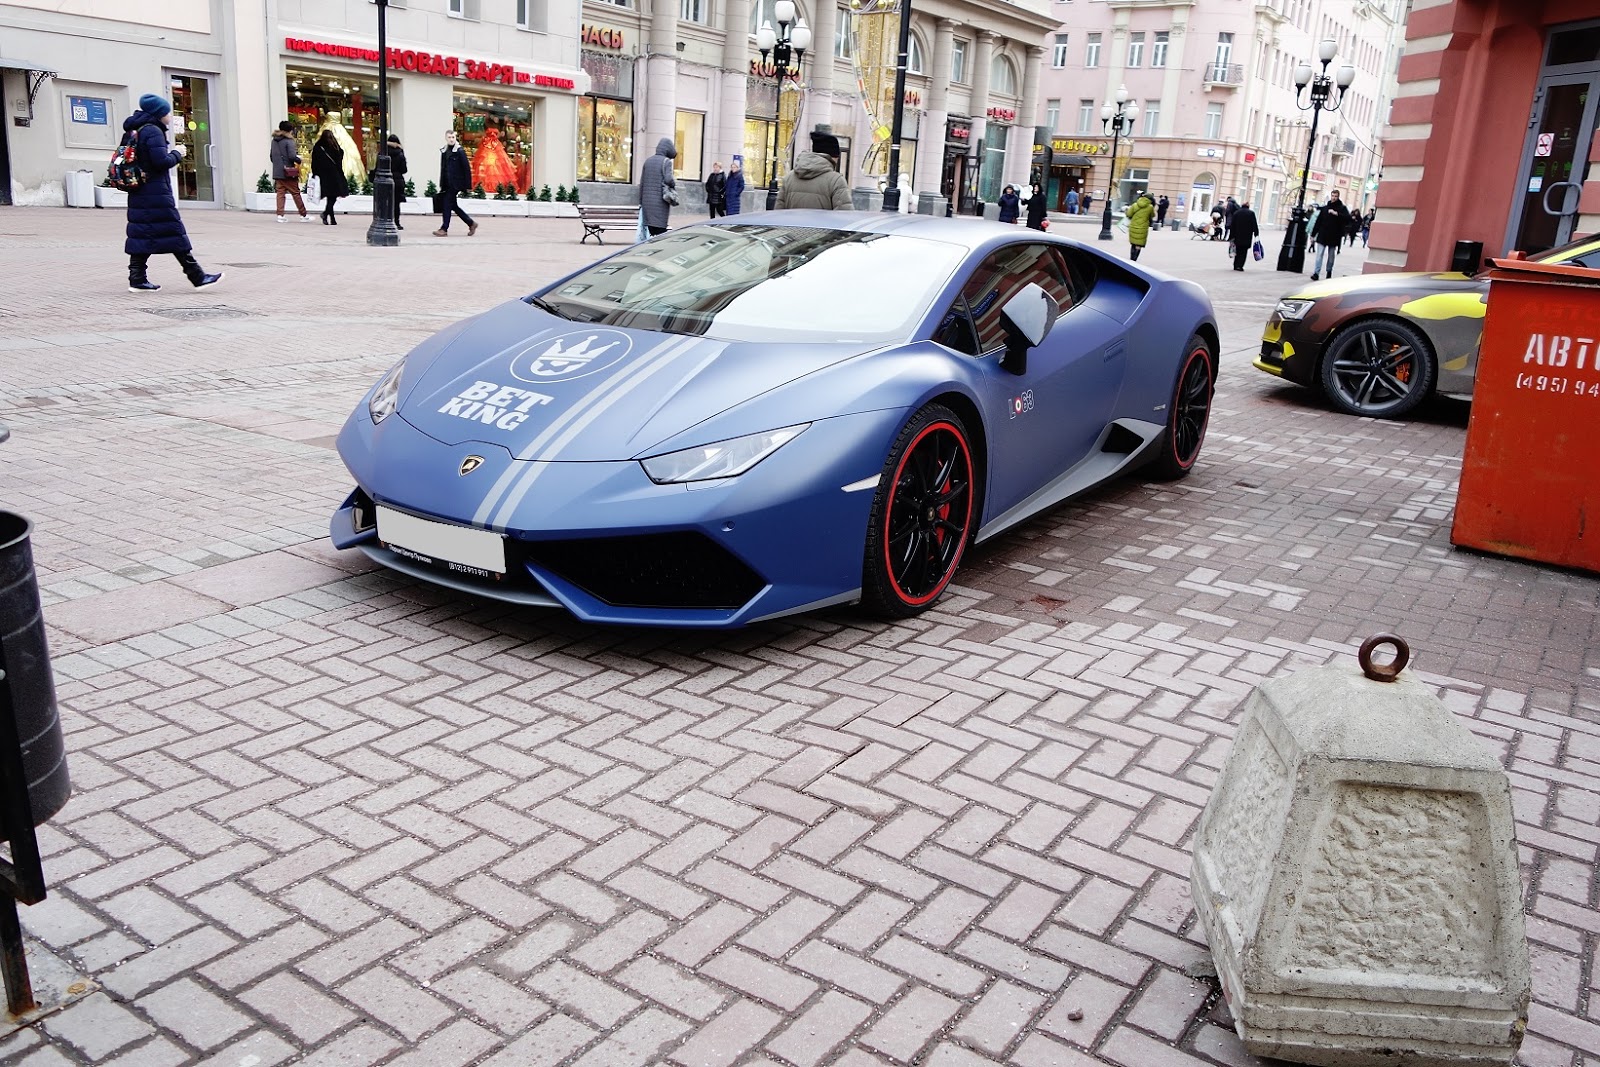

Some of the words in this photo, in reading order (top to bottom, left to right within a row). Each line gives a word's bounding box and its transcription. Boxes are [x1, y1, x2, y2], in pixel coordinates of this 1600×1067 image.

[386, 47, 459, 77] НОВАЯ
[465, 59, 514, 85] ЗАРЯ
[516, 72, 575, 90] КОСМЕТИКА
[1523, 333, 1600, 371] АВТ
[458, 380, 555, 413] BET
[1516, 372, 1568, 394] (495)
[438, 397, 530, 431] KING
